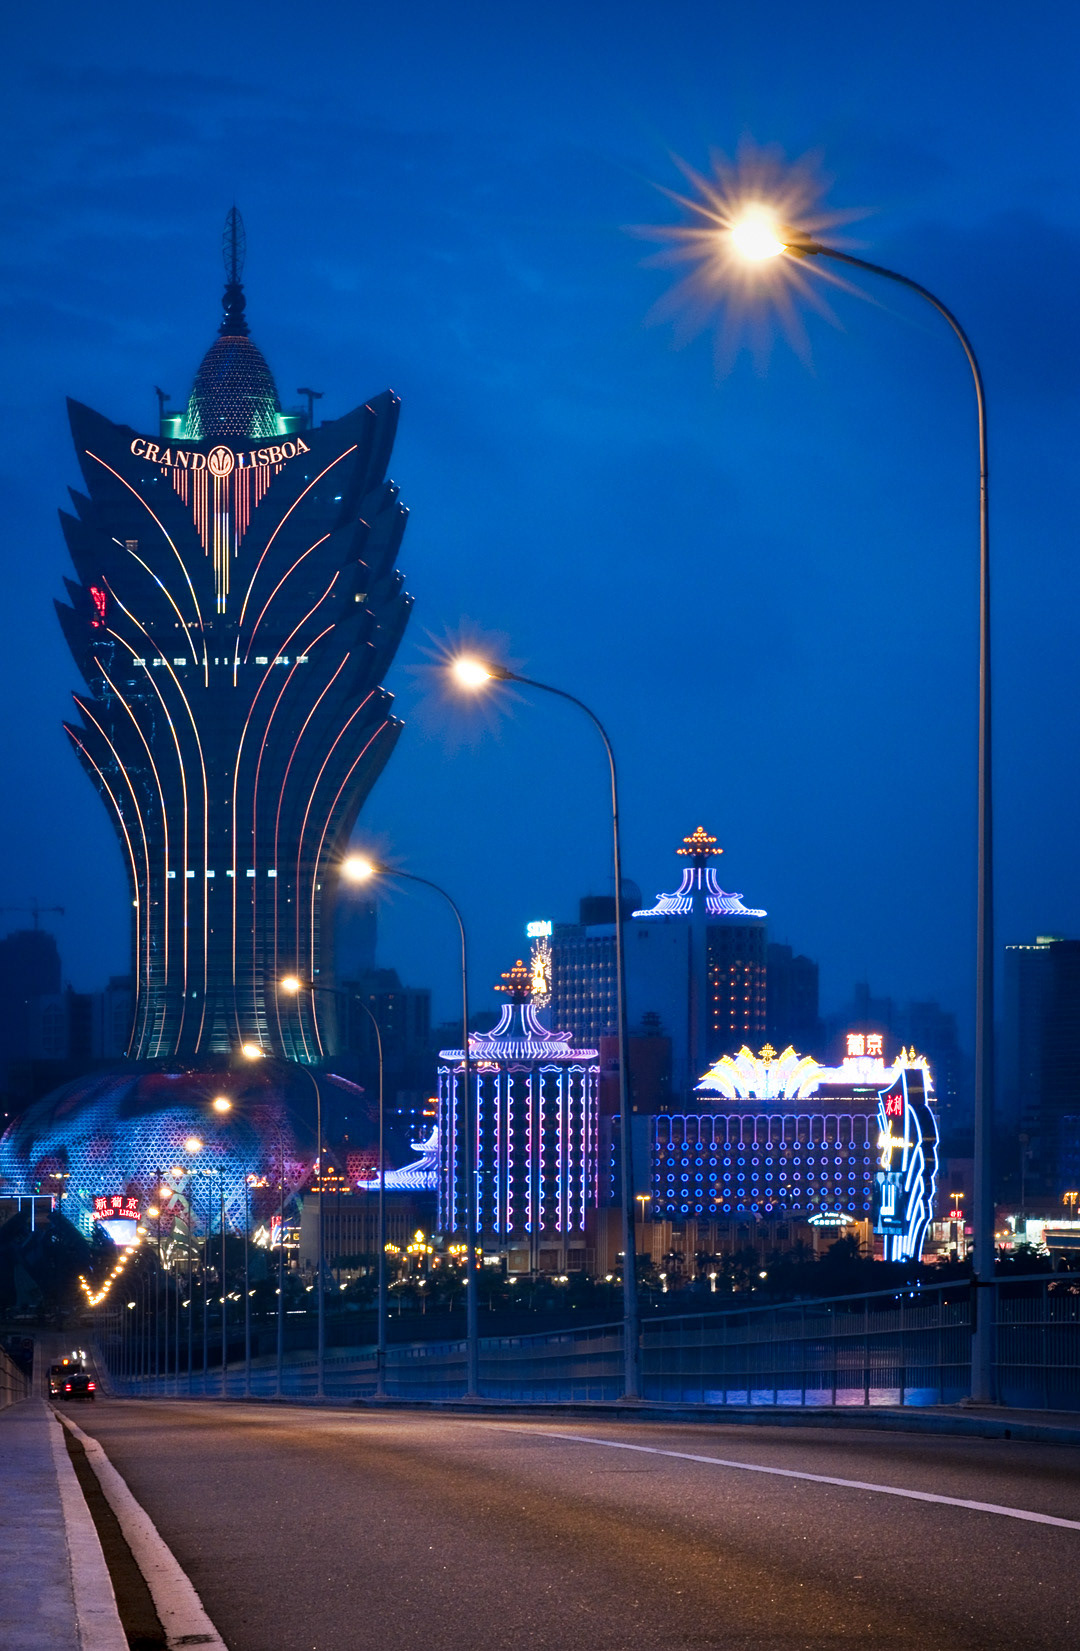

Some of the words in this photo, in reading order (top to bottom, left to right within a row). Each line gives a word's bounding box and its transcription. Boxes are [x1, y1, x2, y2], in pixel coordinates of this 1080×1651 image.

[130, 438, 207, 470] GRAND
[236, 437, 310, 469] LISBOA
[886, 1095, 902, 1116] 永利
[95, 1196, 139, 1210] 新葡京
[92, 1209, 114, 1219] GRAND
[119, 1209, 141, 1220] LISBOA
